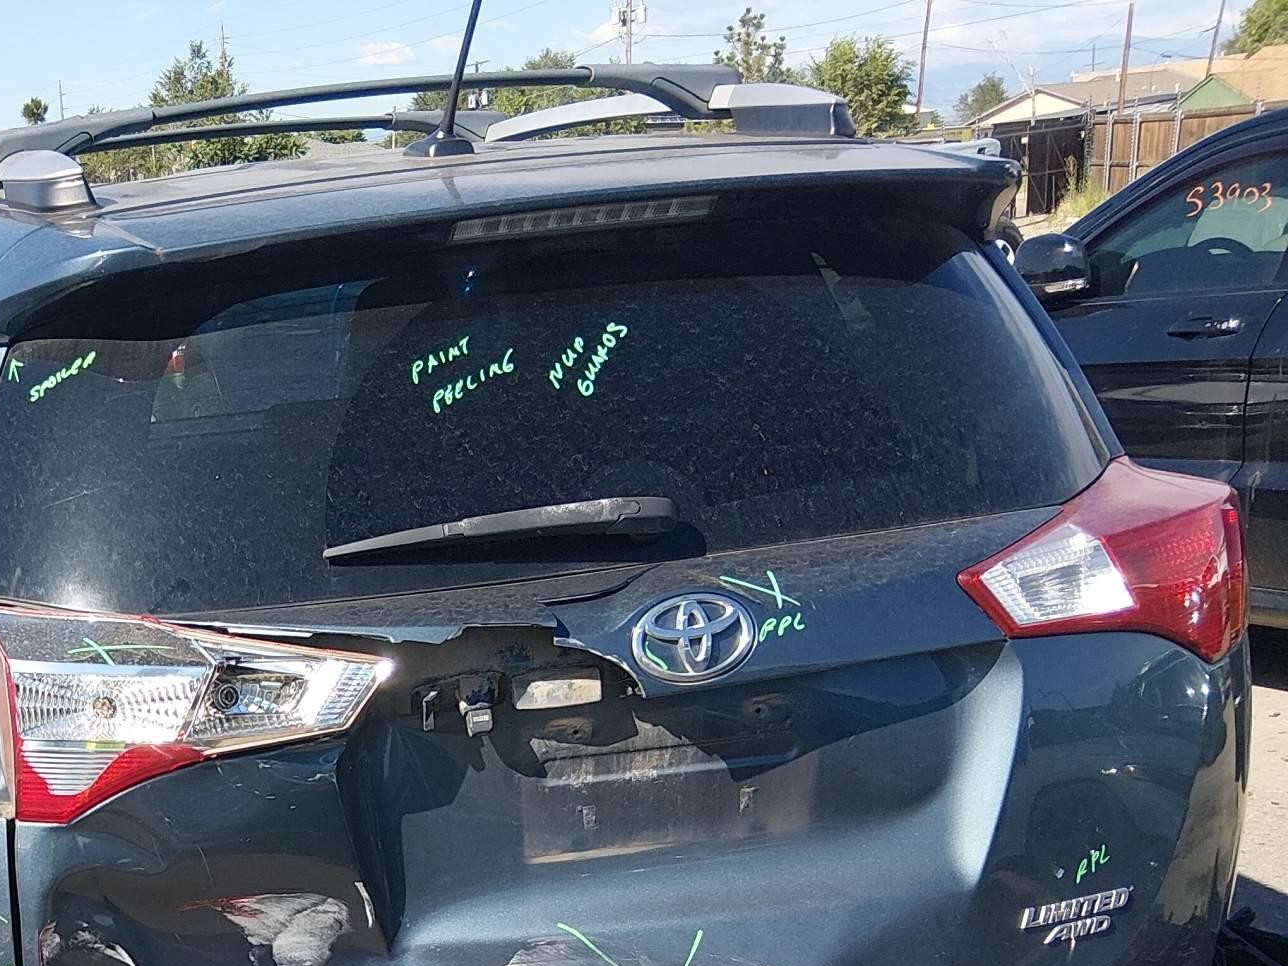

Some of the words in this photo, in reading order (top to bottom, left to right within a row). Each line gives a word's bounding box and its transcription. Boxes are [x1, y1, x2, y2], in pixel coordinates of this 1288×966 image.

[411, 336, 470, 384] PAINT
[432, 348, 514, 414] PEELING
[1020, 887, 1130, 930] LIMITED
[1043, 914, 1112, 945] AWD
